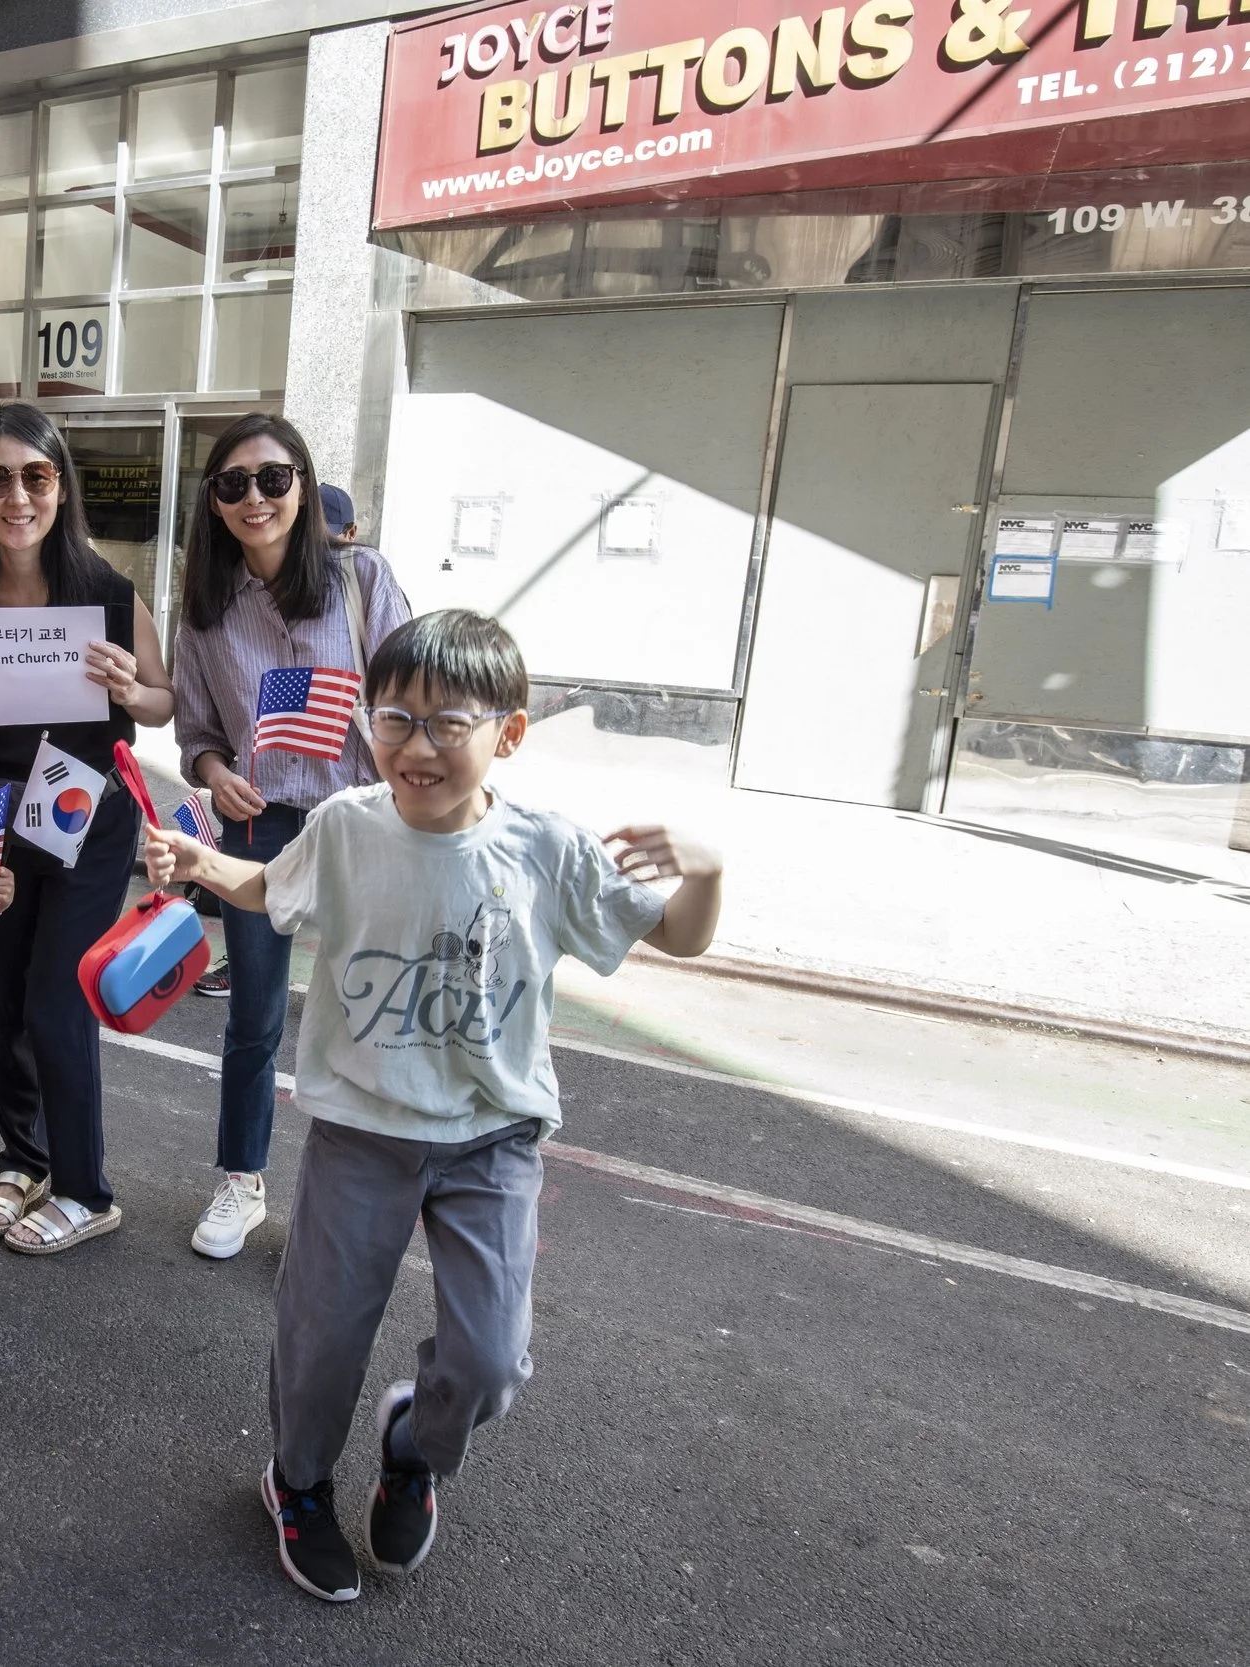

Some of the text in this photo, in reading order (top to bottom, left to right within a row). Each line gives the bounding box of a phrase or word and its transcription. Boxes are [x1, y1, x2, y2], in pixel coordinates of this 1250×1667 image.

[438, 0, 614, 89] JOYCE
[478, 0, 916, 157] BUTTONS
[1017, 69, 1098, 104] TEL.
[1114, 44, 1234, 89] (212)
[421, 127, 713, 200] www.eJoyce.com
[1047, 203, 1126, 235] 109
[1141, 199, 1193, 229] W.
[37, 318, 103, 369] 109
[40, 370, 97, 379] West 38th Street
[1000, 520, 1025, 528] NYC
[1064, 521, 1089, 529] NYC
[38, 627, 67, 642] 교회
[17, 651, 60, 664] Church
[64, 651, 79, 663] 70
[341, 949, 527, 1046] ACE!
